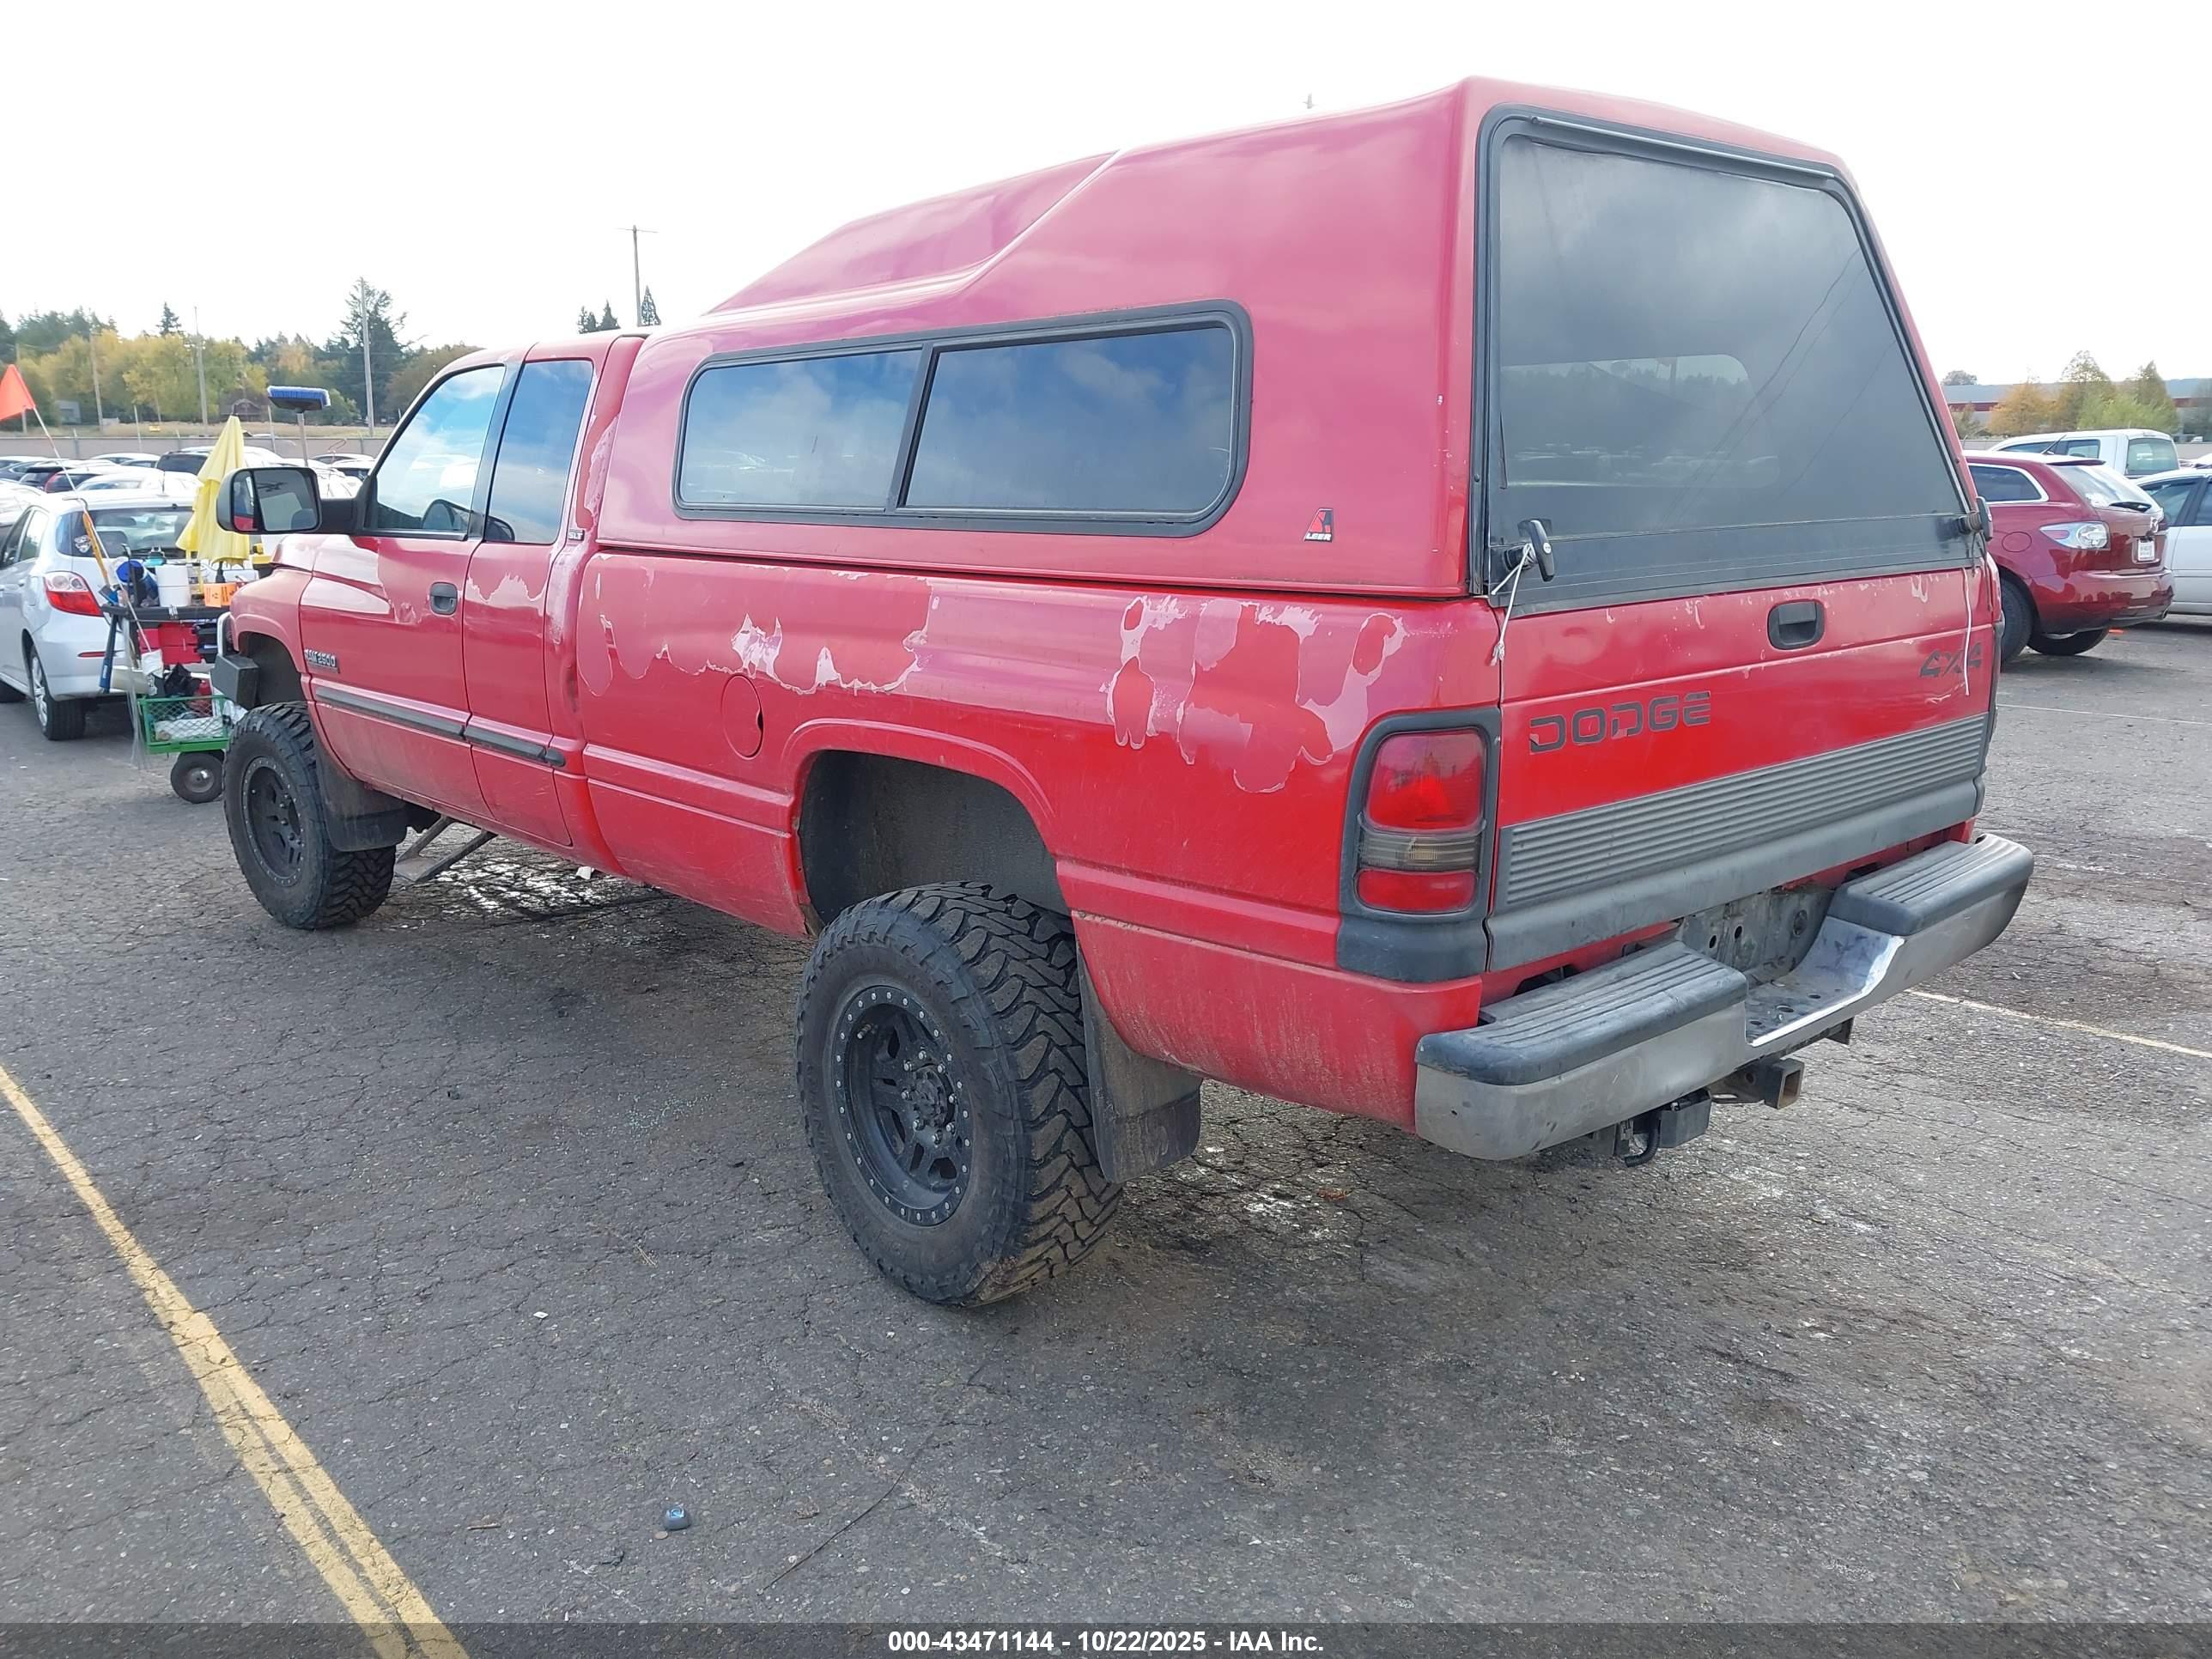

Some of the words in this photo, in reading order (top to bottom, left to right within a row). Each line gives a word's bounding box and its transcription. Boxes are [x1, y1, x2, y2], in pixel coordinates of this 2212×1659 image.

[568, 532, 583, 540] SLT
[1304, 532, 1332, 541] LEER
[317, 652, 336, 667] 2500
[1529, 690, 1711, 755] DODGE
